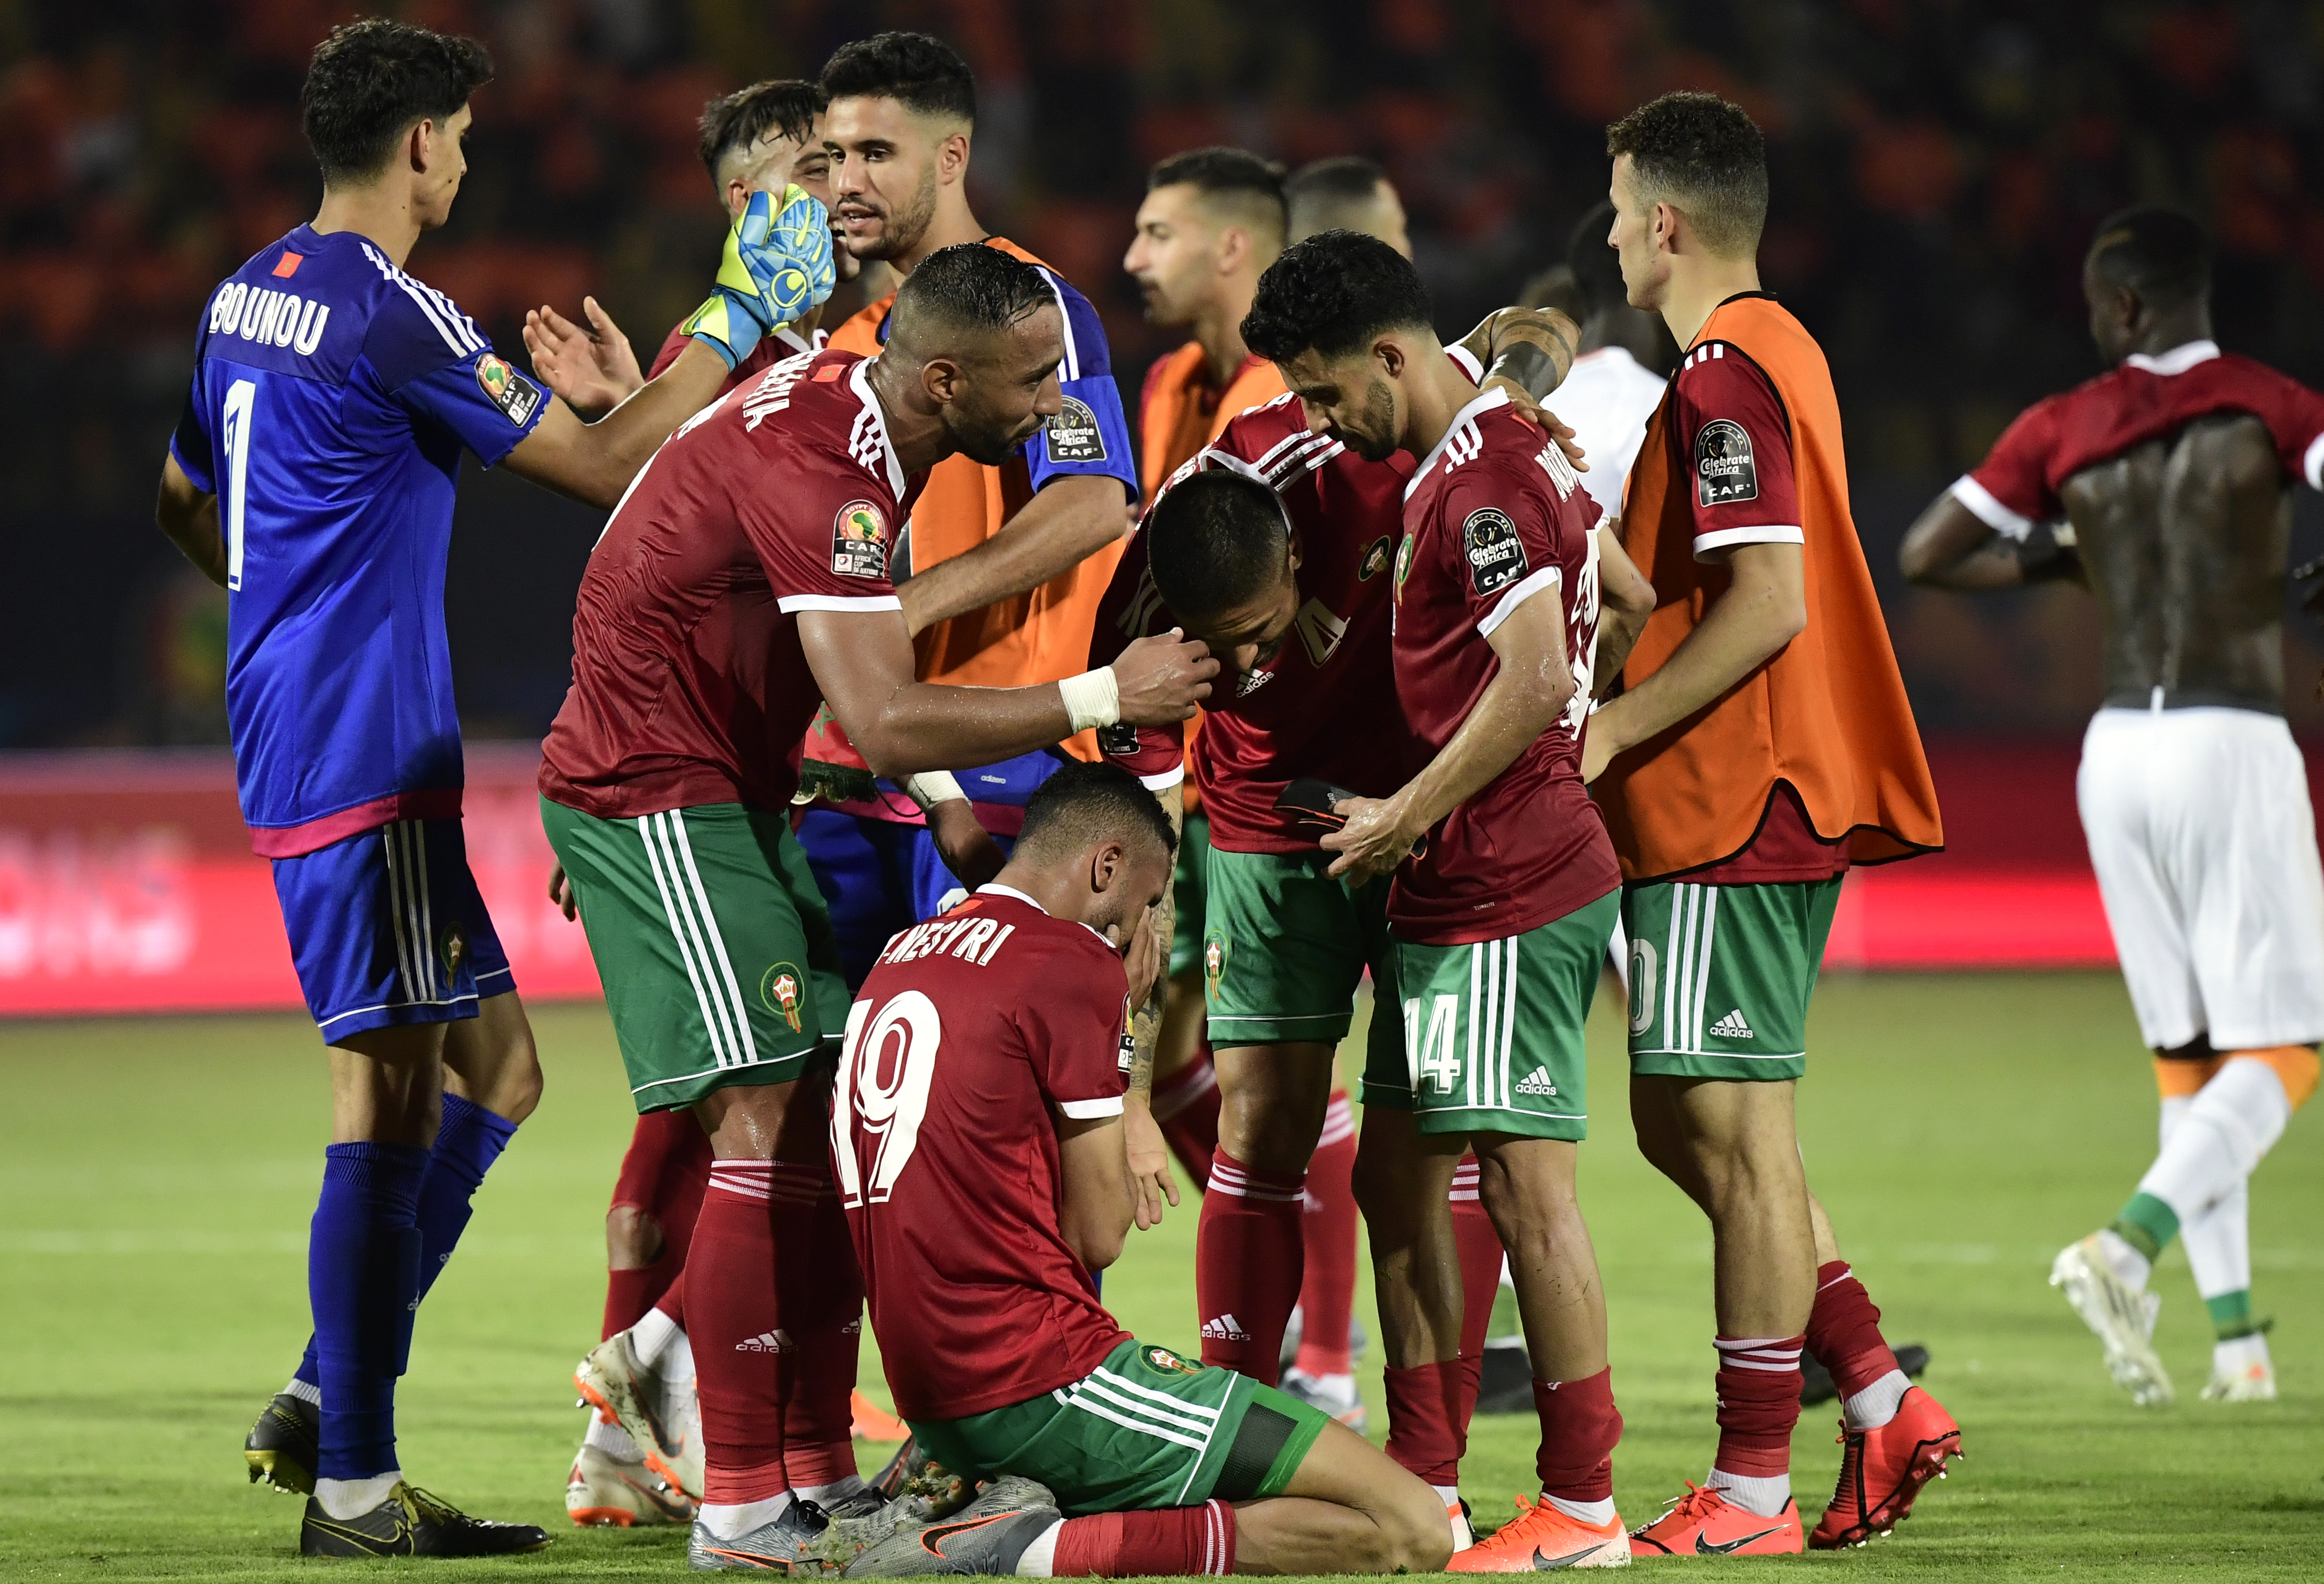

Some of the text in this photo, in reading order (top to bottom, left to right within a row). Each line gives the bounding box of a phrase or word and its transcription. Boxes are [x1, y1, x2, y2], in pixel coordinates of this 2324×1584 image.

[209, 282, 329, 355] BOUNOU
[502, 382, 516, 404] CAF
[1058, 436, 1088, 446] Africa
[1058, 447, 1093, 456] CAF
[1700, 455, 1749, 475] Celebrate
[1708, 465, 1739, 479] Africa
[223, 379, 255, 591] 1
[1708, 484, 1744, 497] CAF
[846, 504, 868, 514] EGYPT
[846, 541, 877, 552] CAF
[1469, 538, 1517, 565] Celebrate
[854, 555, 871, 563] AFRICA
[1479, 549, 1509, 569] Africa
[860, 567, 878, 576] NATIONS
[1483, 566, 1517, 586] CAF
[1236, 672, 1274, 697] adidas
[1709, 1026, 1753, 1039] adidas
[1125, 1038, 1135, 1047] CA
[1404, 995, 1461, 1098] 14
[1515, 1083, 1556, 1096] adidas
[829, 990, 941, 1209] 19
[1201, 1329, 1251, 1341] adidas
[735, 1343, 799, 1354] adidas
